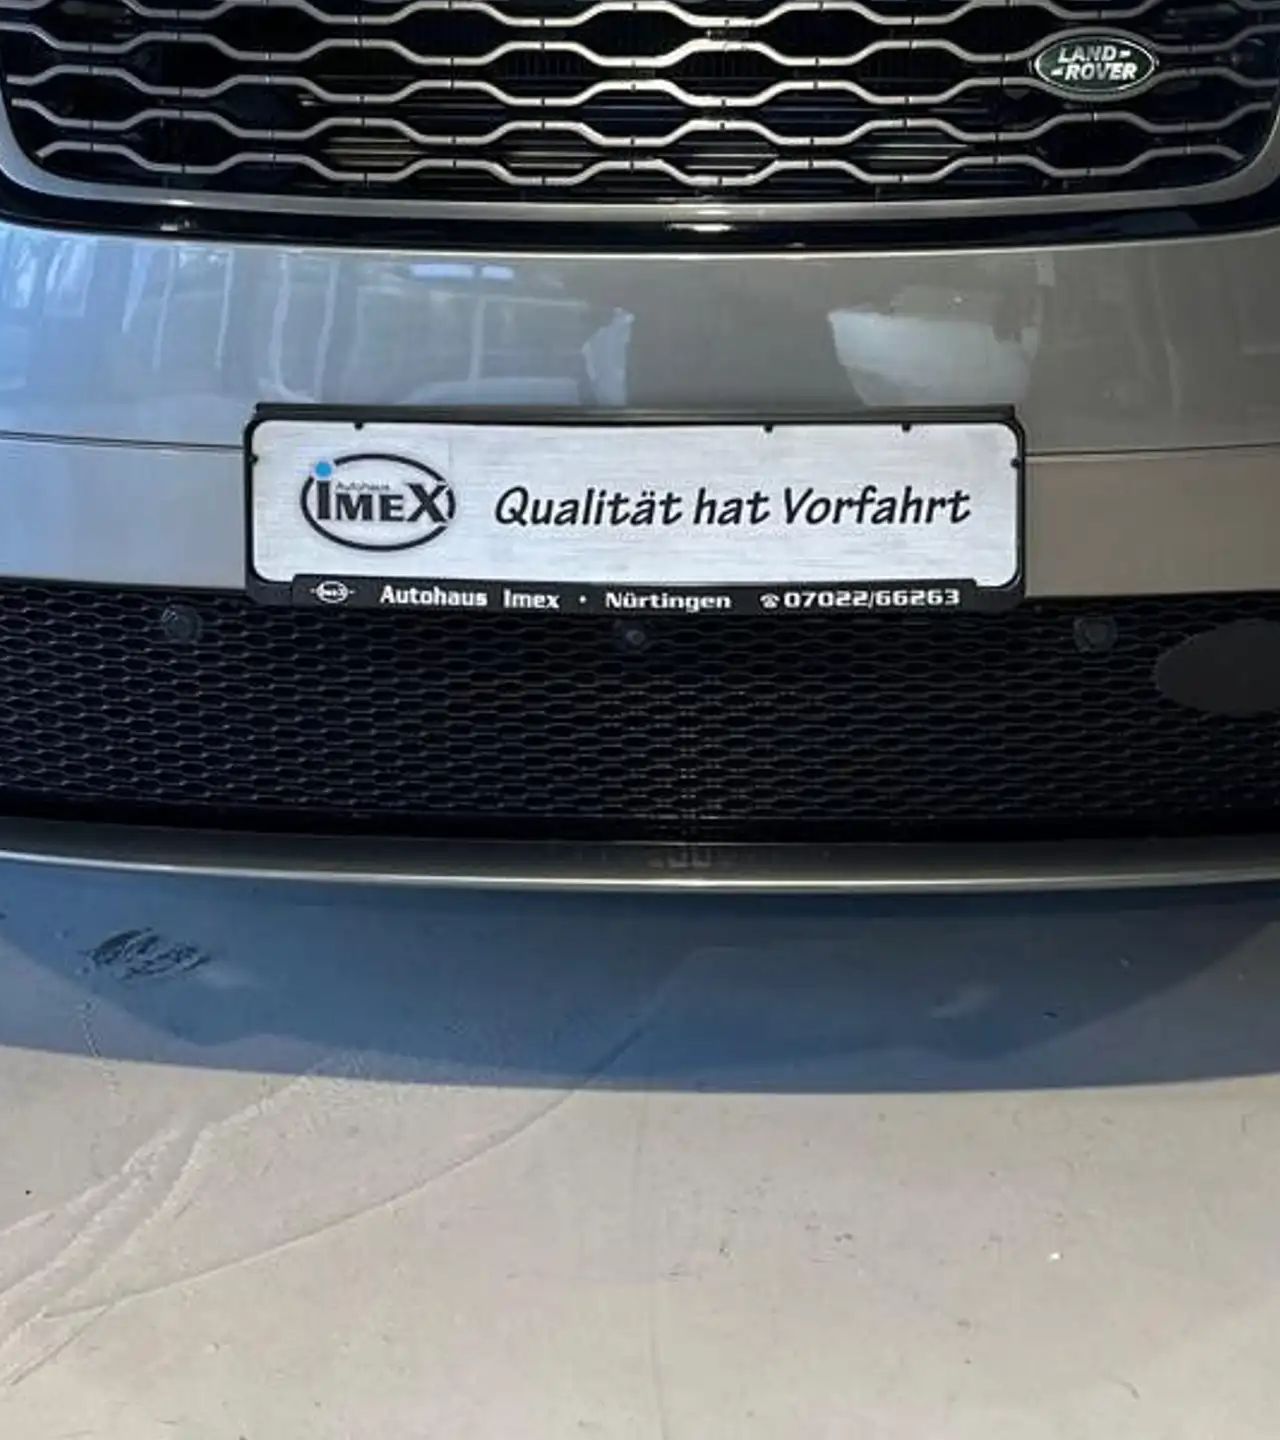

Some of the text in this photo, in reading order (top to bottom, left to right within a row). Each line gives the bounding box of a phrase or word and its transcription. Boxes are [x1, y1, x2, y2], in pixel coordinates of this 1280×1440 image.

[494, 485, 971, 526] Qualität hat Vorfahrt
[380, 584, 961, 612] Autohaus Imex Nürtingen 07022/66263
